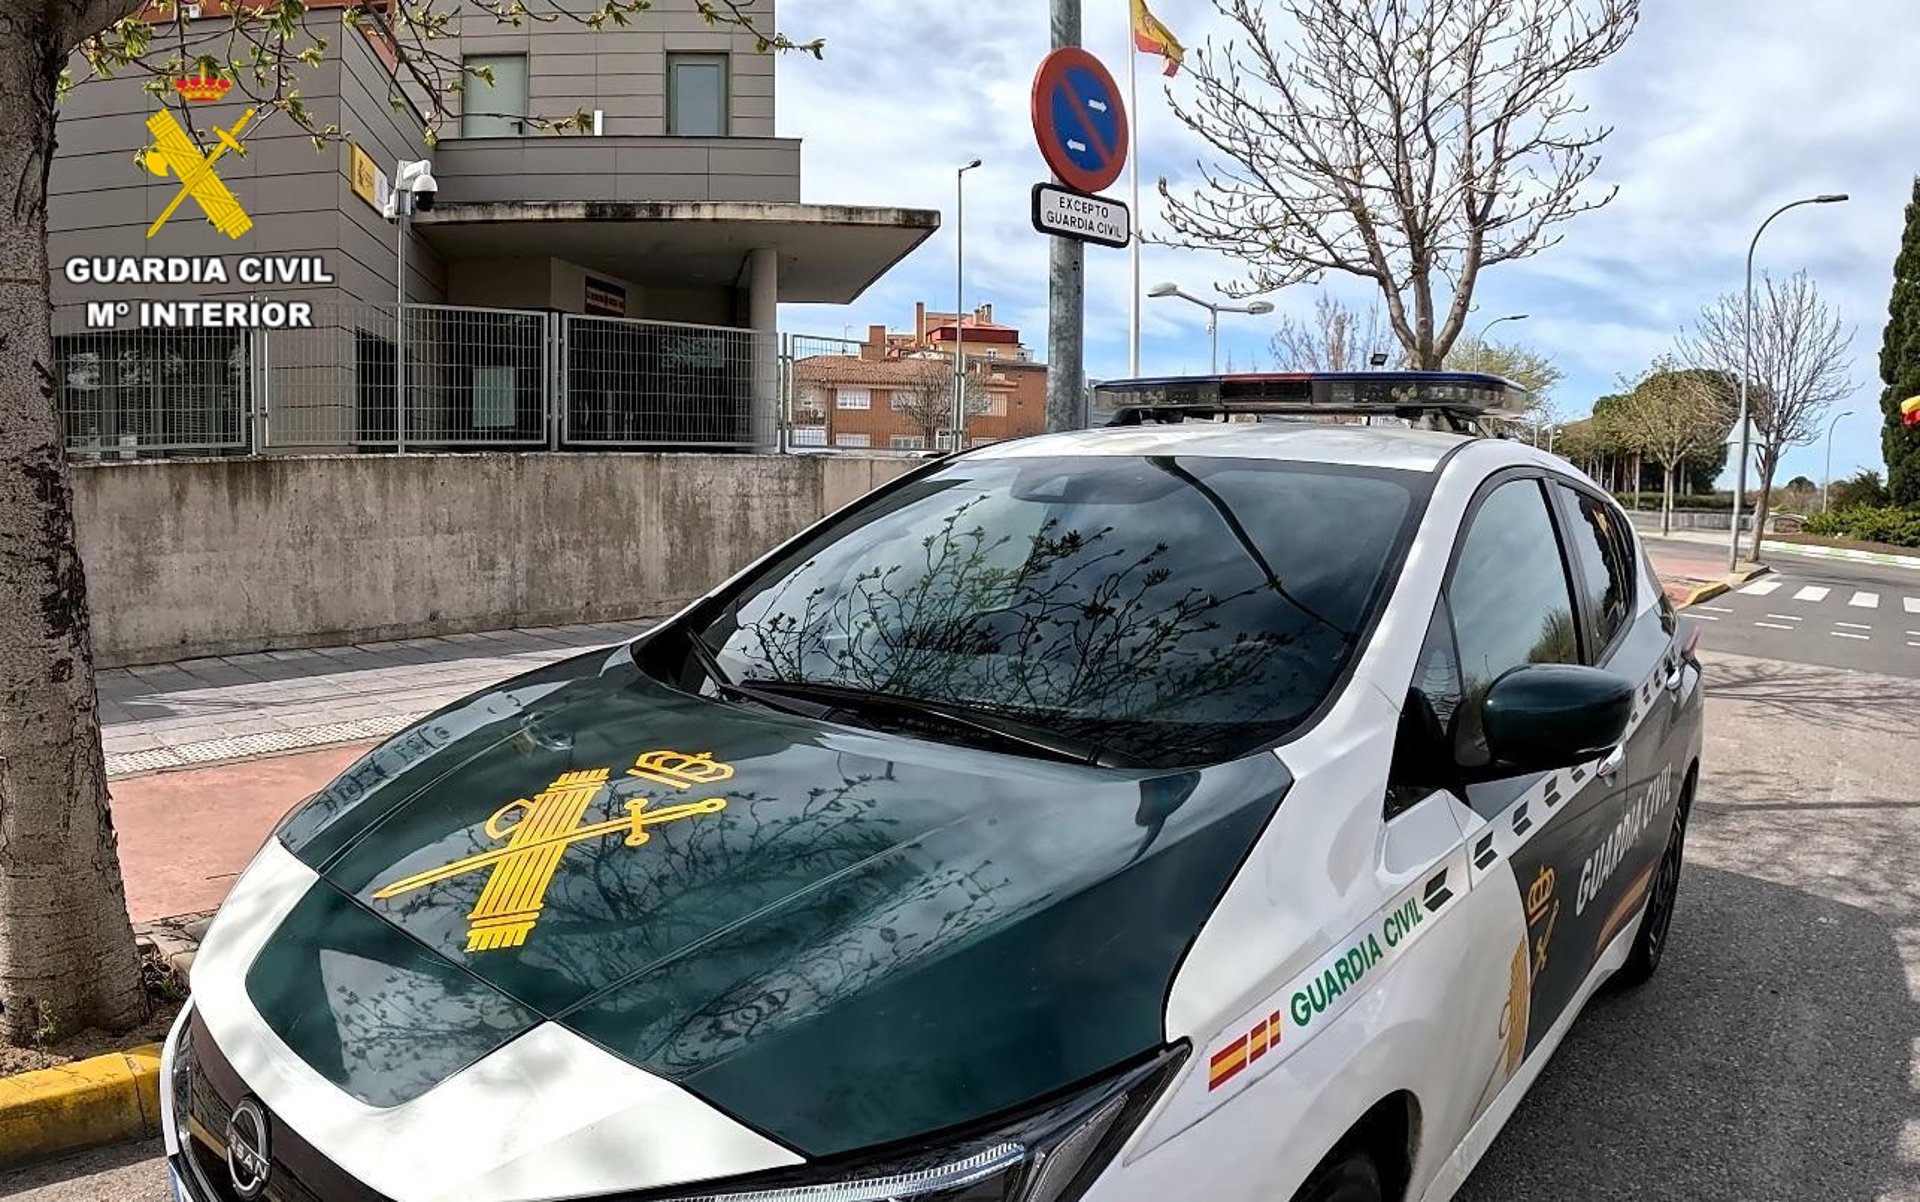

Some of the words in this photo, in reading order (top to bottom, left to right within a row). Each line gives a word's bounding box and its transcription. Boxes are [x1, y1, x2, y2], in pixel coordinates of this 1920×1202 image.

[1046, 210, 1095, 232] GUARDIA
[1096, 222, 1122, 238] CIVIL
[1059, 196, 1109, 218] EXCEPTO
[1576, 797, 1643, 917] GUARDIA
[1643, 762, 1673, 830] CIVIL
[1290, 932, 1383, 1027] GUARDIA
[1383, 897, 1424, 948] CIVIL
